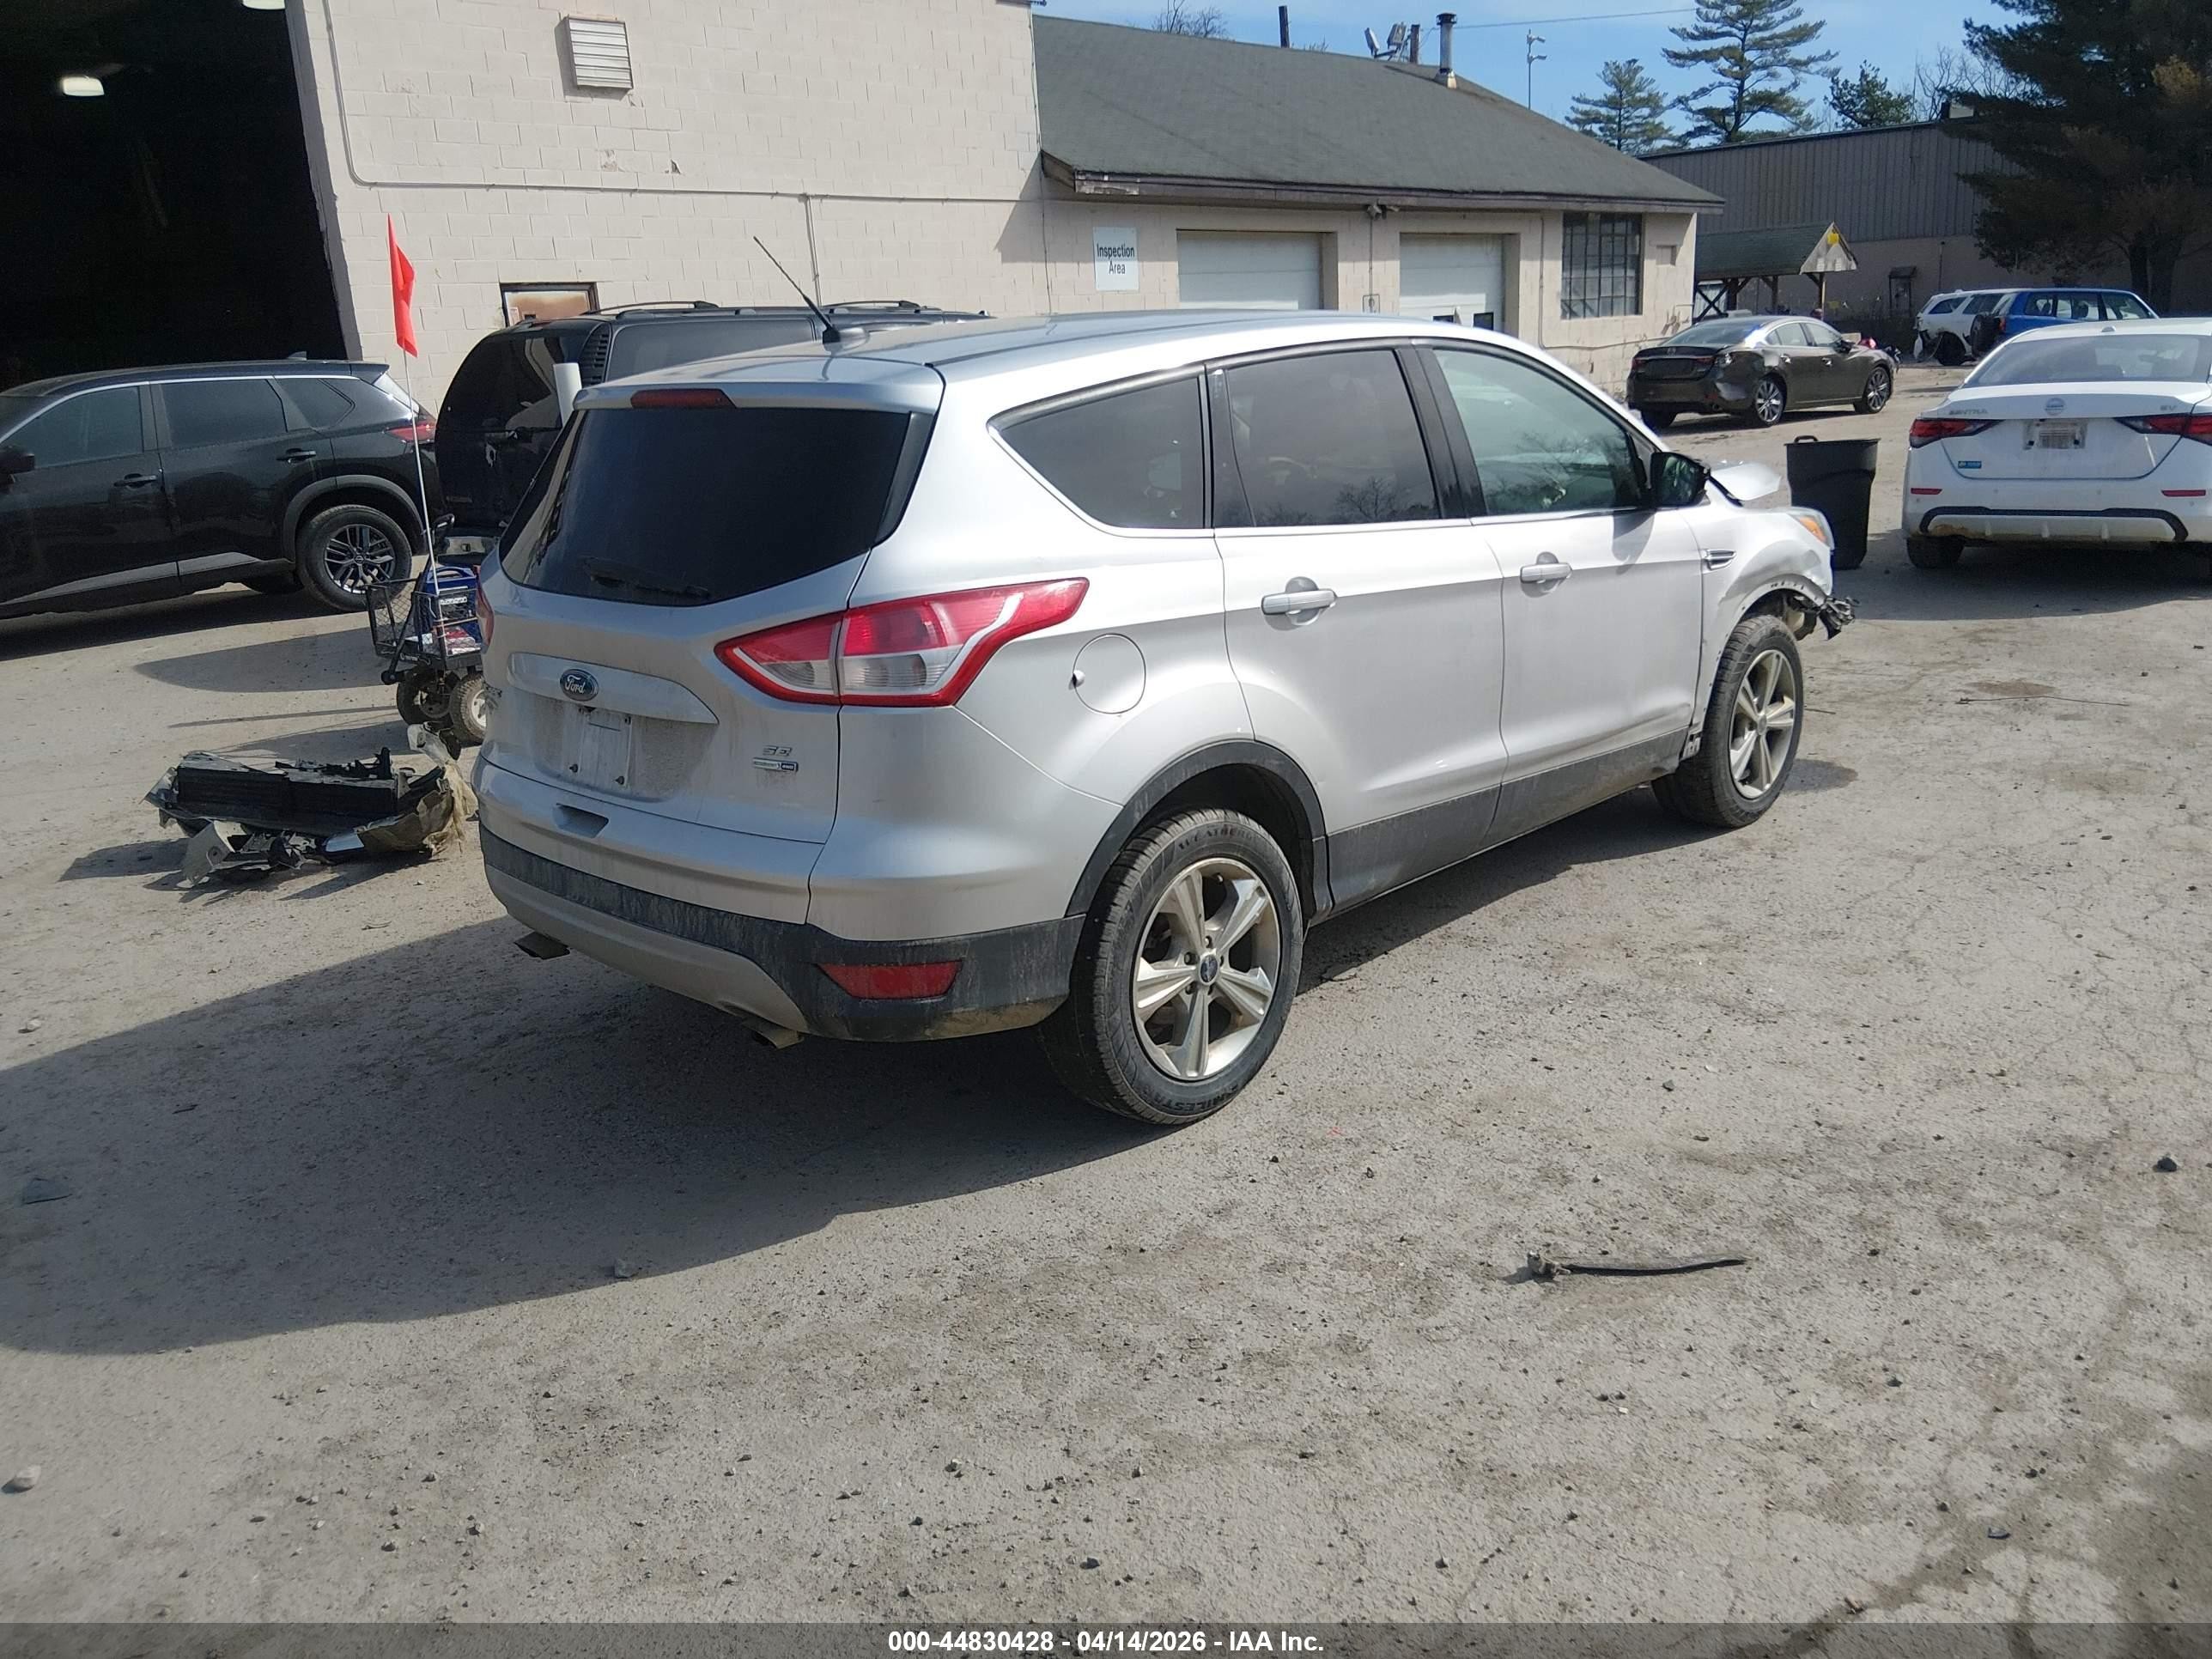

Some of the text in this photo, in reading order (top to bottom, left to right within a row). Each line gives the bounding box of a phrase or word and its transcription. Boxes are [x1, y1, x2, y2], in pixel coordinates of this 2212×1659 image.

[1097, 243, 1135, 260] Inspection
[1109, 261, 1126, 275] Area
[564, 674, 586, 695] Ford
